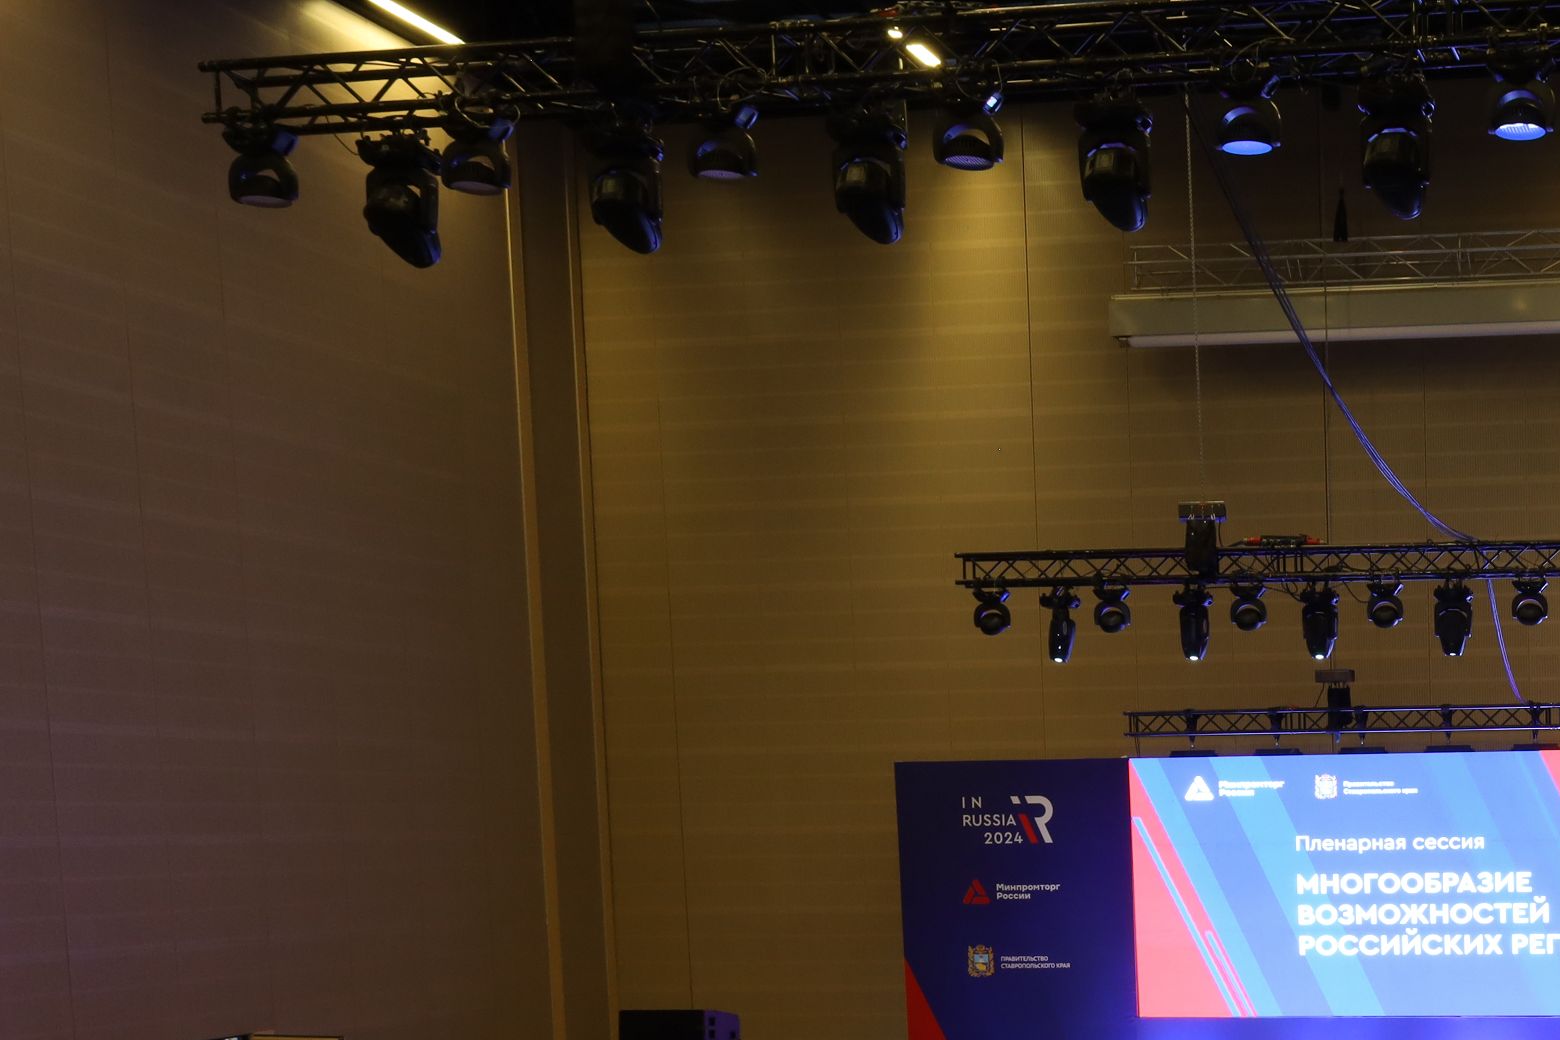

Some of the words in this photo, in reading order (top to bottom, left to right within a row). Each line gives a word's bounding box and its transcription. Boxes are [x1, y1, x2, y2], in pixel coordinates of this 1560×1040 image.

[962, 814, 1017, 827] RUSSIA
[984, 832, 1024, 844] 2024
[1295, 835, 1406, 854] Пленарная
[1413, 836, 1485, 851] сессия
[996, 883, 1061, 892] Минпромторг
[1296, 871, 1533, 895] МНОГООБРАЗИЕ
[997, 892, 1031, 900] России
[1297, 896, 1550, 925] ВОЗМОЖНОСТЕЙ
[1299, 928, 1502, 956] РОССИЙСКИХ
